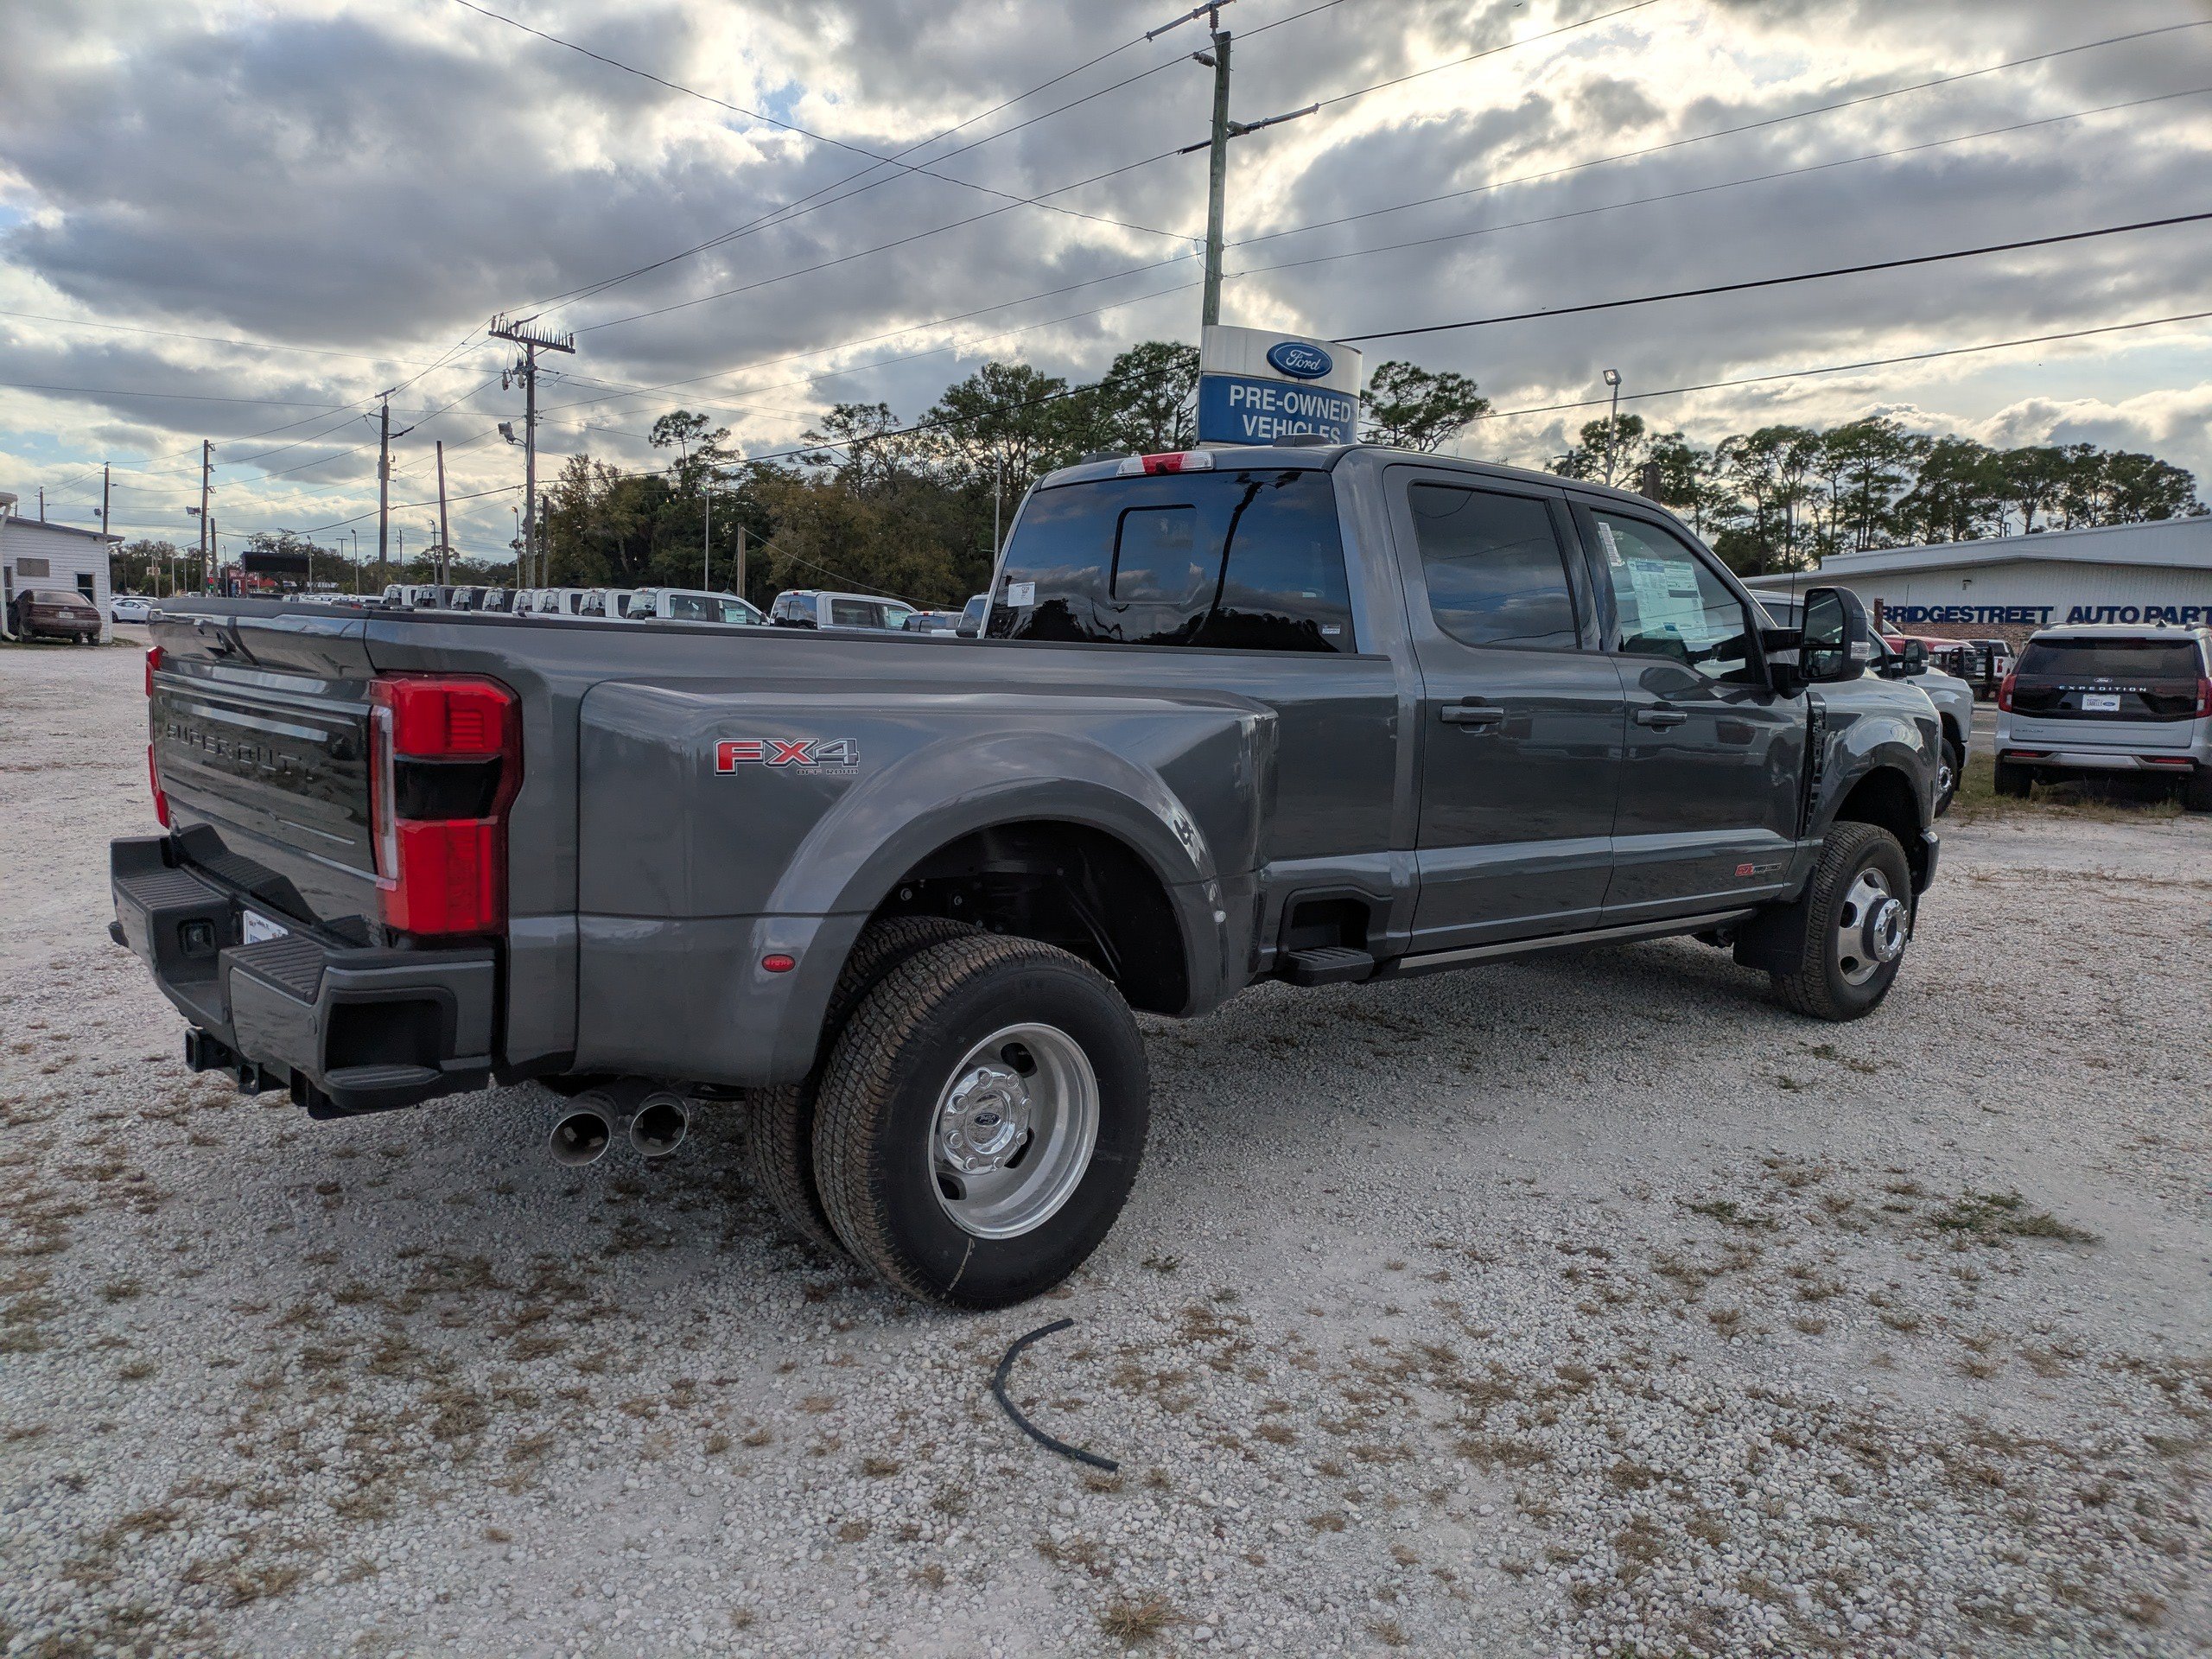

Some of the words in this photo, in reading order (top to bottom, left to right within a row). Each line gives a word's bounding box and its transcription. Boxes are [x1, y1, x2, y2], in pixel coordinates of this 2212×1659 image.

[1286, 349, 1321, 371] Ford
[1230, 385, 1351, 423] PRE-OWNED
[1883, 606, 2054, 624] BRIDGESTREET
[2066, 606, 2139, 625] AUTO
[714, 738, 860, 776] FX4
